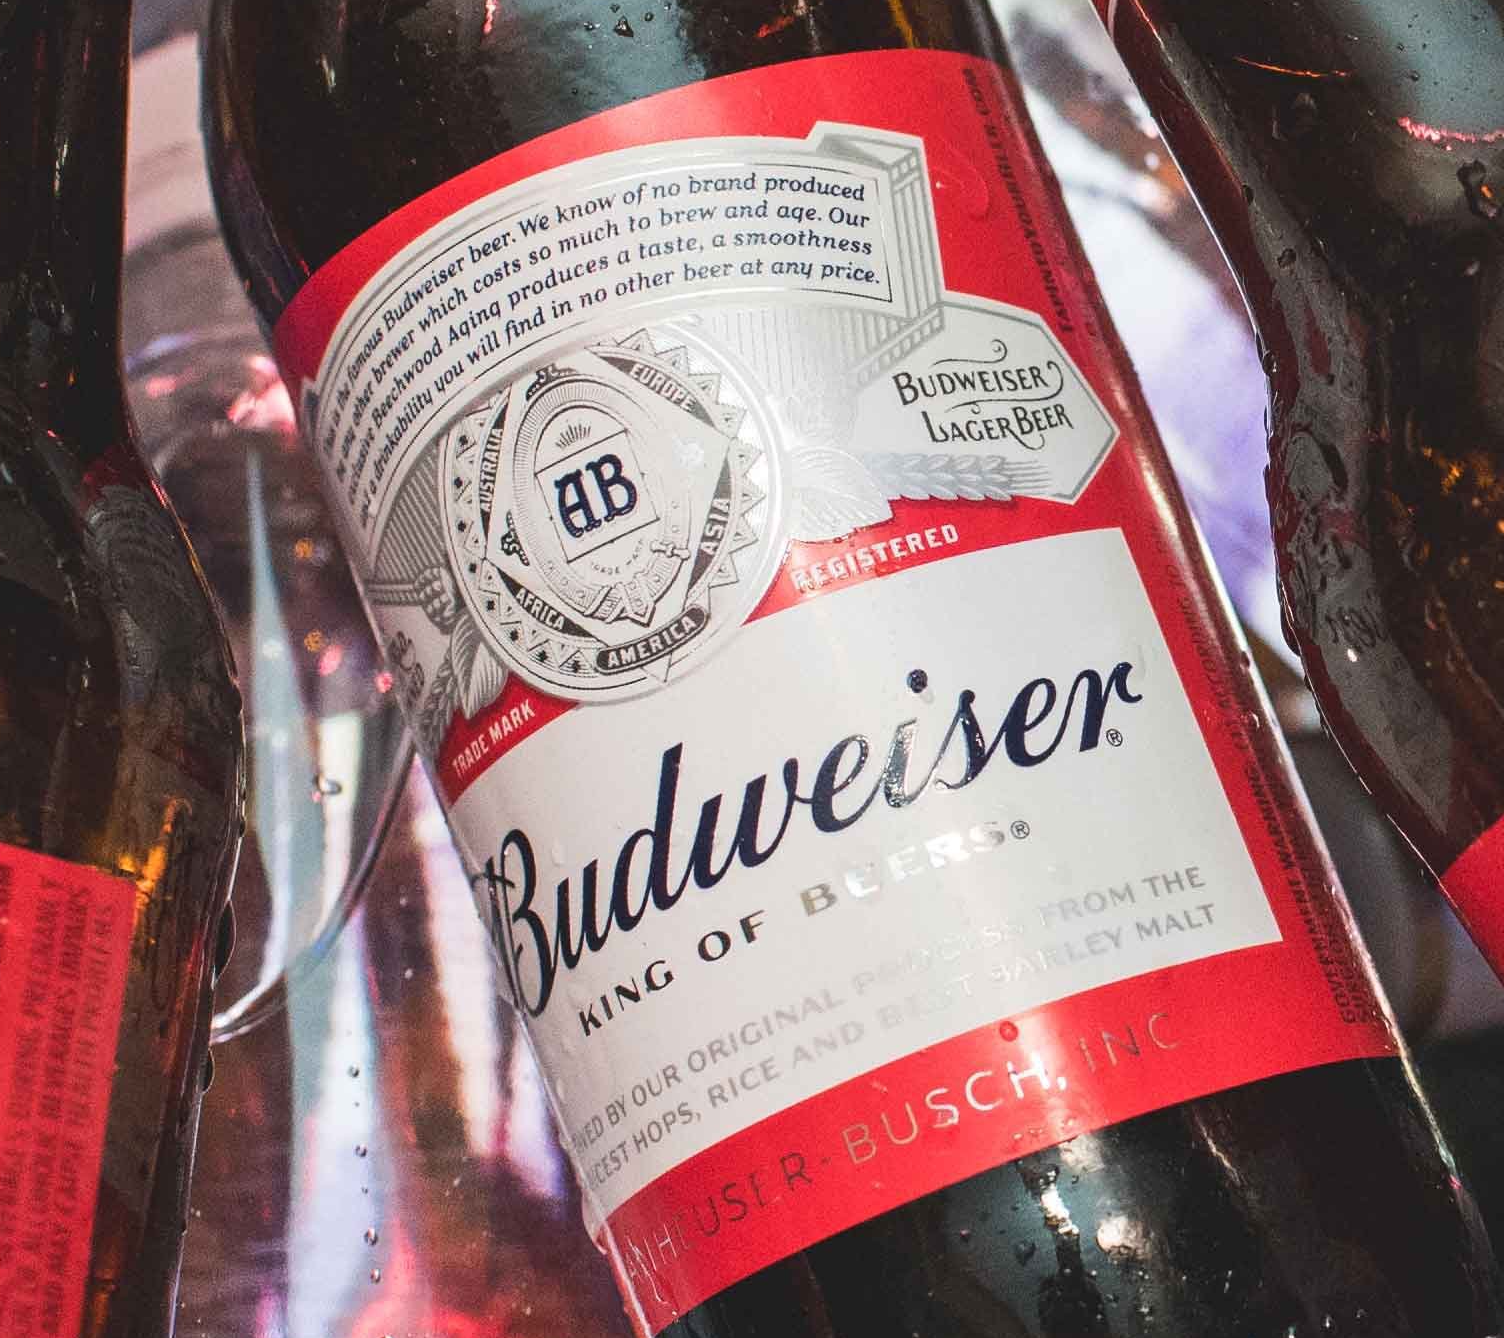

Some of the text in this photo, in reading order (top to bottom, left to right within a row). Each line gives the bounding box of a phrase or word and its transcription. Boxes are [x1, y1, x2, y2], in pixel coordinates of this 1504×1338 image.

[383, 172, 866, 333] Budweiser beer. We know of no brand produced
[417, 199, 871, 334] which costs so much to brew and Our
[371, 228, 873, 430] Beechwood produces taste, smoothness
[433, 257, 881, 404] you will find in no other beer at any price.
[631, 362, 697, 411] EUROPE
[892, 363, 1056, 406] BUDWEISER
[921, 410, 1016, 446] LAGER
[554, 453, 637, 538] AB
[702, 496, 731, 557] ASIA
[790, 523, 961, 594] REGISTERED
[515, 589, 567, 631] AFRICA
[607, 614, 698, 671] AMERICA
[452, 698, 536, 781] TRADE MARK
[475, 659, 1143, 1019] Budweiser
[579, 960, 675, 1037] KING
[698, 909, 765, 963] OF
[606, 865, 1207, 1125] BY OUR ORIGINAL FROM THE
[633, 903, 1218, 1154] HOPS, RICE AND MALT
